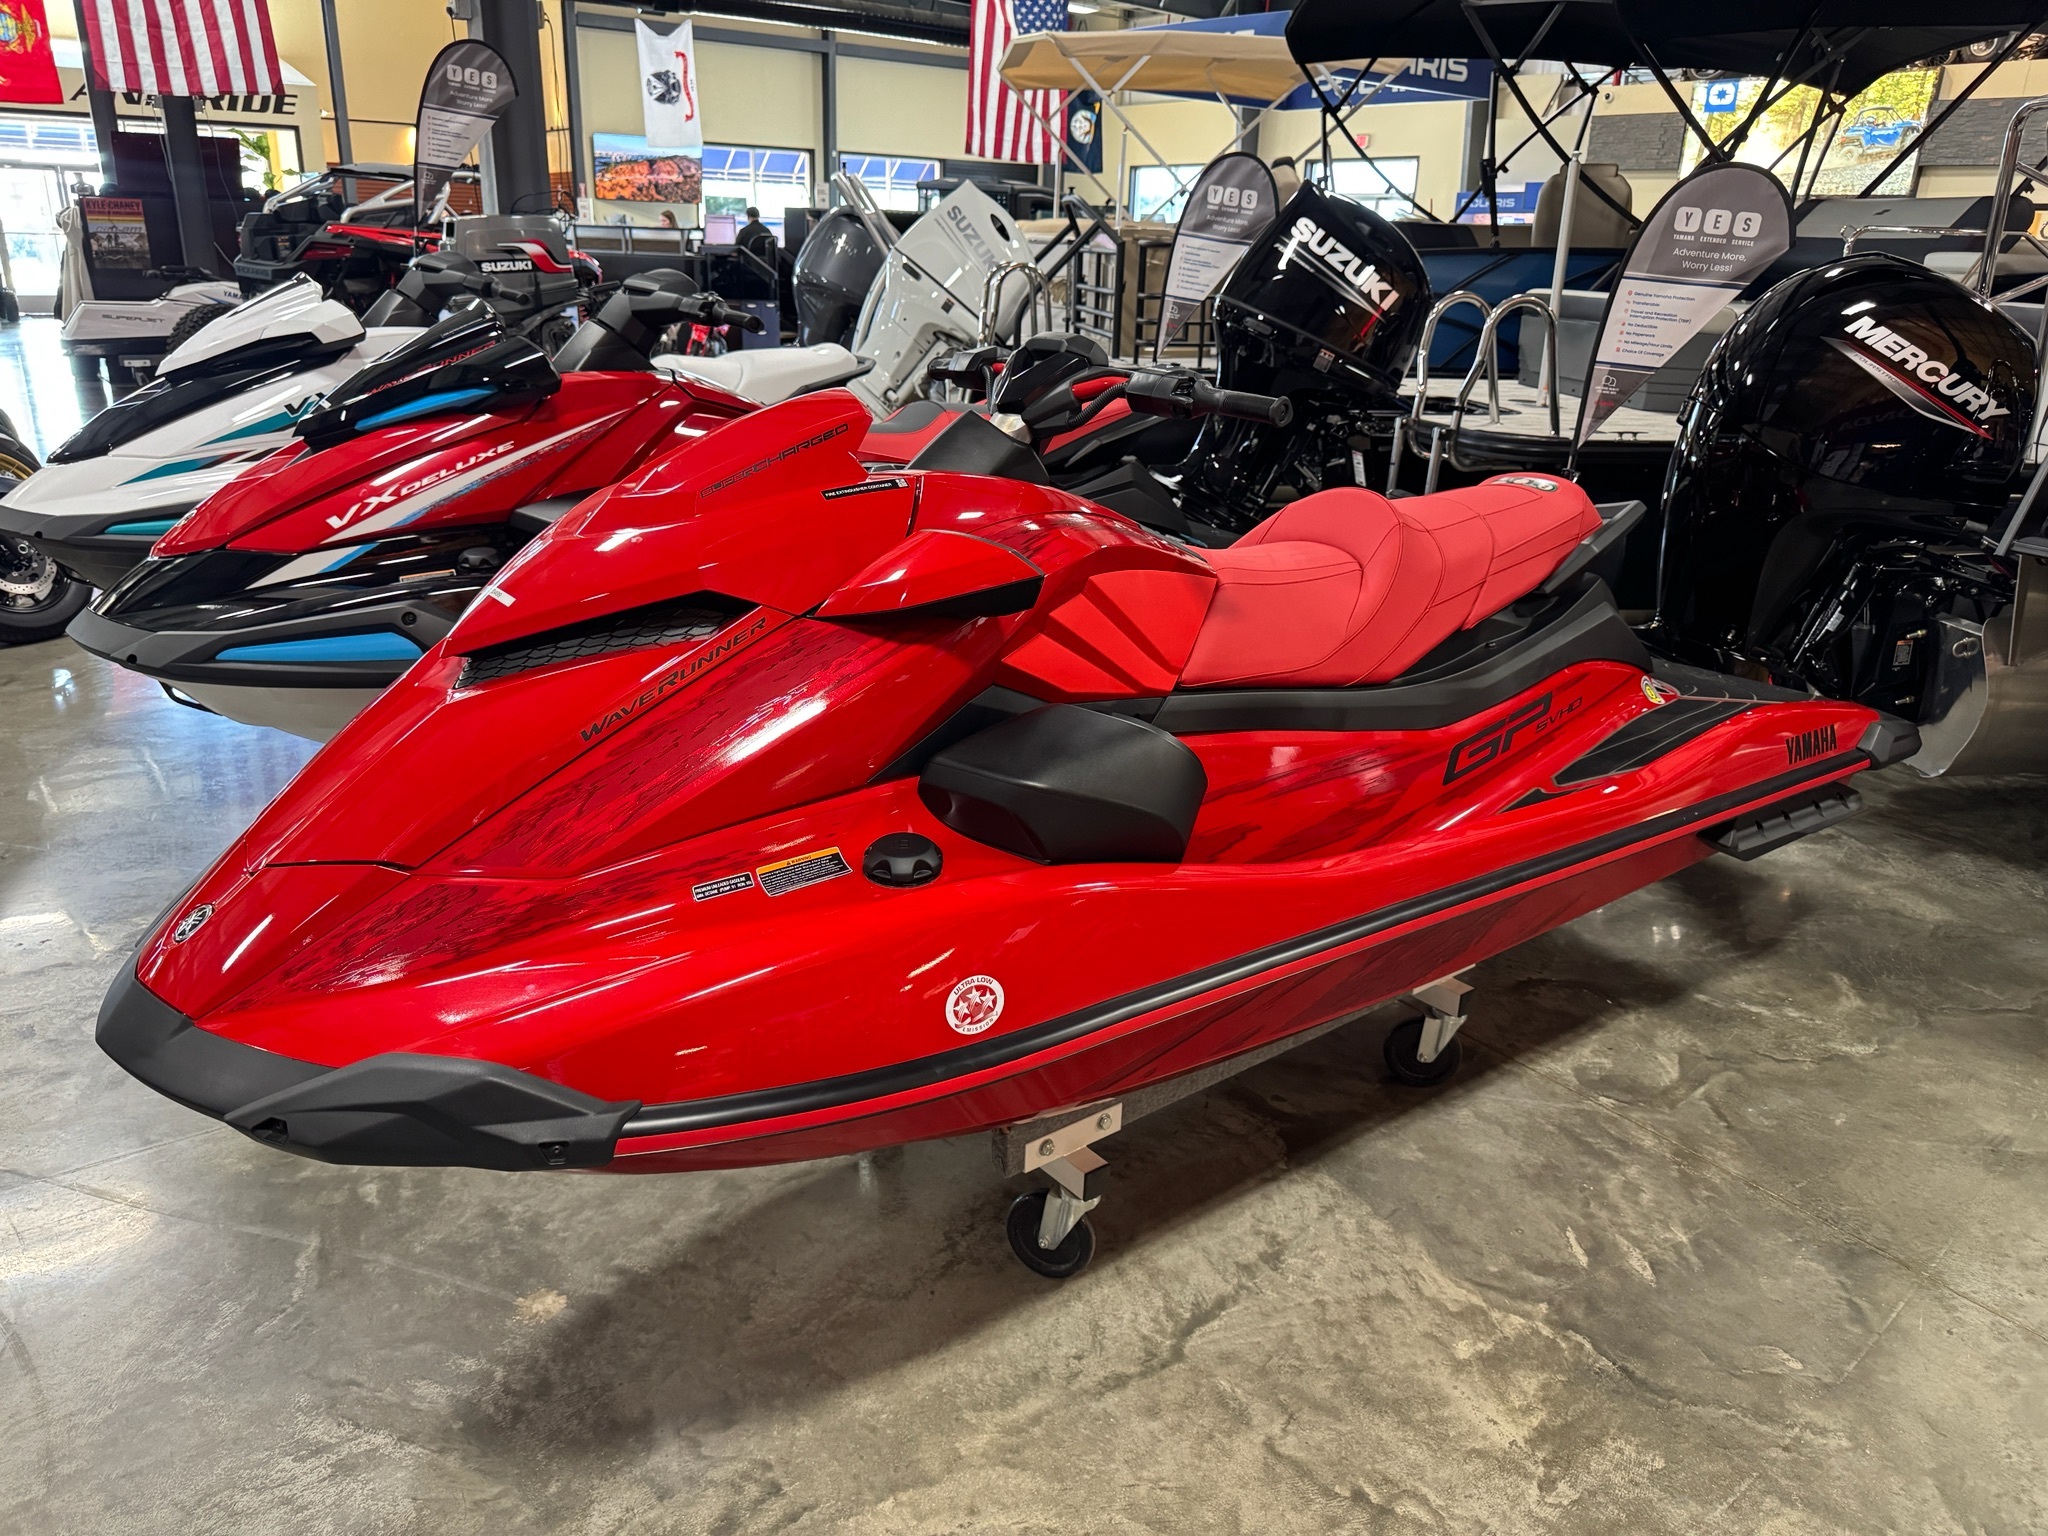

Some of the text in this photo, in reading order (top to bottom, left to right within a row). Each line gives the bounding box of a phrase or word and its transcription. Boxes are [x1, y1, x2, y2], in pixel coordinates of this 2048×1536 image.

[450, 66, 494, 86] YES
[85, 200, 140, 210] KYLE CHANEY
[1211, 187, 1254, 206] YES
[1460, 198, 1515, 208] POLRIS
[1681, 210, 1755, 234] YES
[947, 205, 1002, 272] SUZUK
[1700, 236, 1727, 244] EXTENDED
[1731, 239, 1754, 247] SERVICE
[1290, 216, 1400, 311] SUZUKI
[1672, 247, 1747, 262] Adventure More,
[481, 260, 533, 272] SUZUKI
[1682, 260, 1733, 272] Worry Less!
[1844, 316, 2011, 420] MERCURY
[700, 423, 849, 499] SUPERCHARGED
[325, 440, 515, 530] VX DELUXE
[579, 616, 766, 741] WAVERUNNER
[1442, 691, 1583, 786] GP SVHO
[1785, 724, 1837, 766] YAMAHA
[791, 855, 812, 864] WARNING
[962, 1017, 994, 1032] EMISSION
